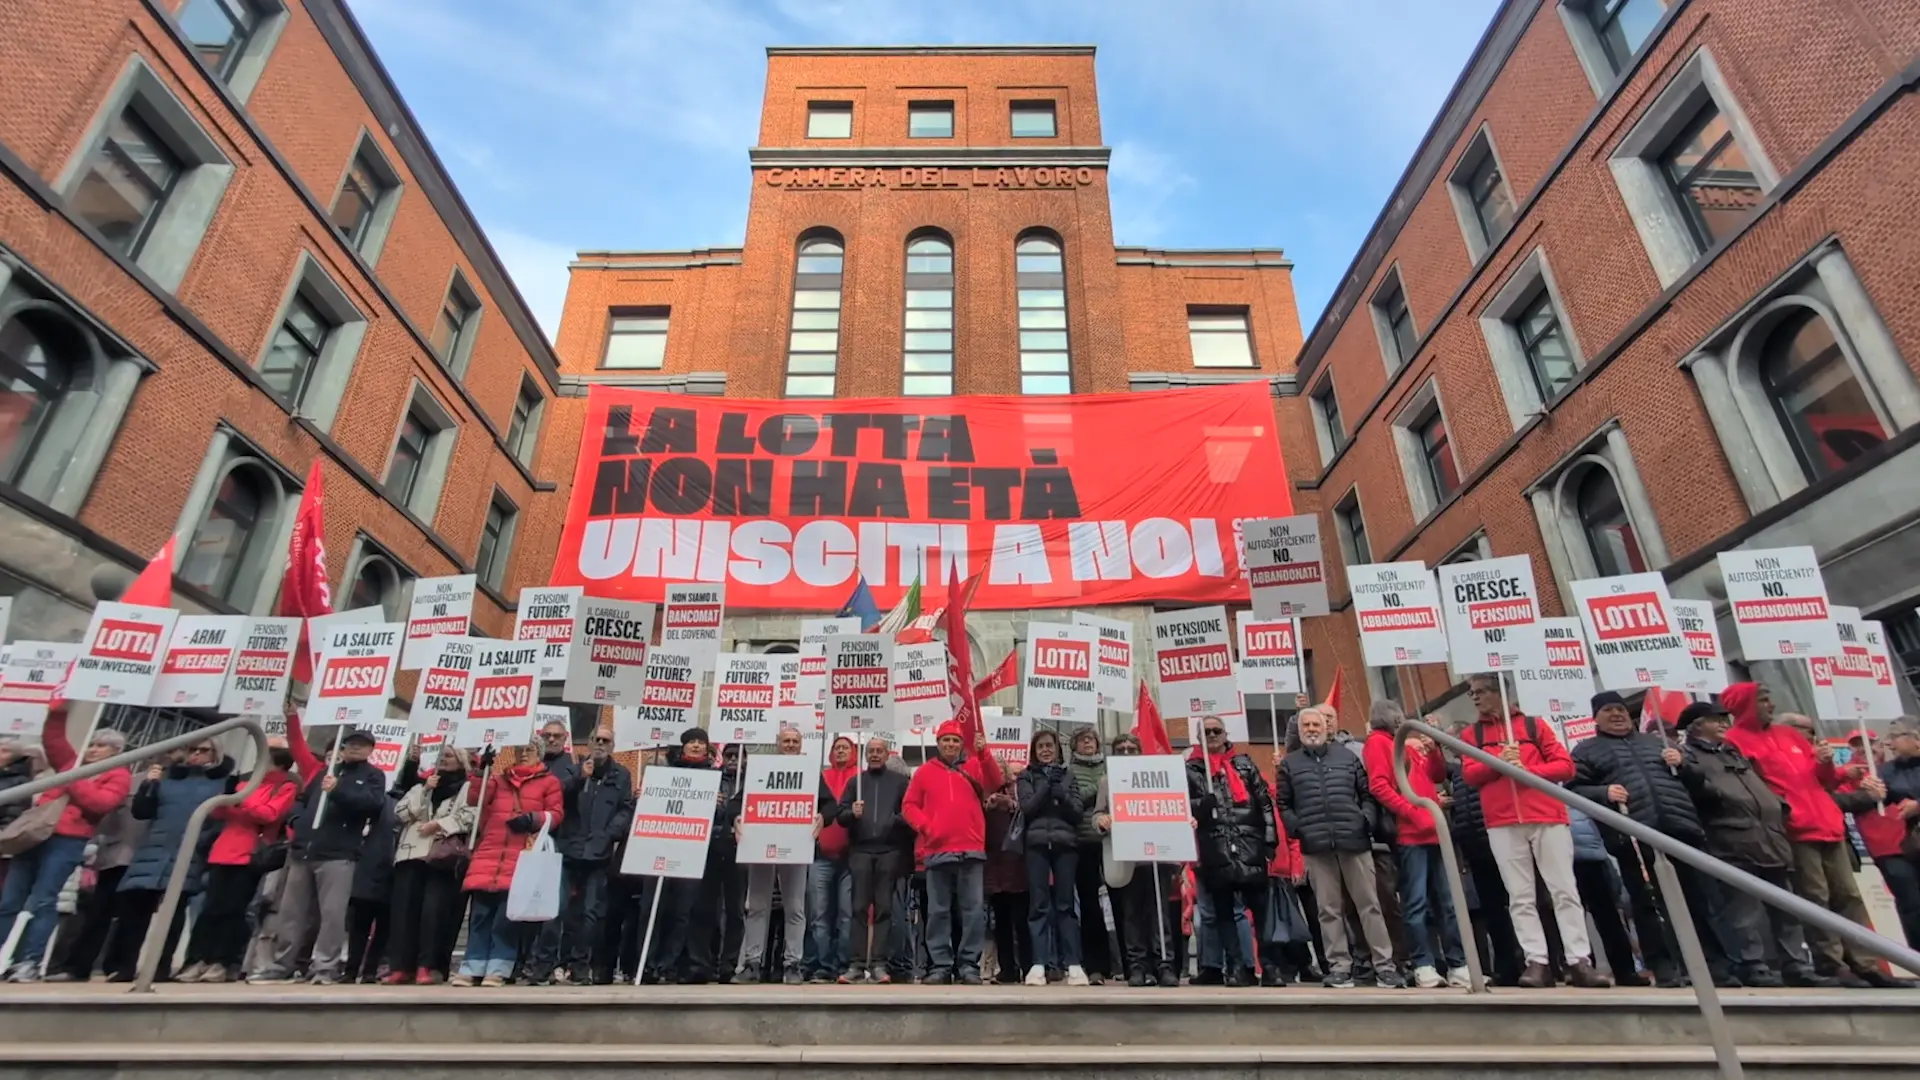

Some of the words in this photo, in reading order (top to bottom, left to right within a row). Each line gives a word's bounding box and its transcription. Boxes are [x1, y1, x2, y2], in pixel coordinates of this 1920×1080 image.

[765, 167, 887, 187] CAMERA
[900, 167, 959, 187] DEL
[972, 167, 1093, 187] LAVORO
[601, 404, 697, 456] LA
[715, 412, 976, 463] LOTTA
[588, 457, 774, 516] NON
[789, 460, 910, 518] HA
[927, 448, 1082, 520] ETÀ
[1269, 525, 1290, 537] NON
[1248, 534, 1316, 550] AUTOSUFFICIENTI?
[578, 517, 969, 586] UNISCITI
[988, 524, 1052, 585] A
[1067, 517, 1225, 581] NOI
[1755, 558, 1780, 569] NON
[1377, 571, 1397, 582] NON
[1452, 574, 1459, 584] IL
[1461, 570, 1500, 583] CARRELLO
[1728, 568, 1814, 583] AUTOSUFFICIENTI?
[436, 584, 452, 593] NON
[1355, 580, 1425, 594] AUTOSUFFICIENTI?
[1455, 577, 1527, 603] CRESCE,
[533, 594, 568, 604] PENSIONI
[672, 593, 687, 602] NON
[688, 593, 710, 602] SIAMO
[712, 593, 718, 601] IL
[528, 605, 570, 618] FUTURE?
[595, 608, 629, 618] CARRELLO
[668, 610, 719, 623] BANCOMAT
[1458, 606, 1467, 615] LE
[1472, 604, 1531, 624] PENSIONI
[1594, 603, 1664, 631] LOTTA
[189, 629, 226, 644] ARMI
[521, 622, 570, 639] SPERANZE
[585, 618, 644, 640] CRESCE,
[667, 629, 680, 640] DEL
[682, 629, 716, 639] GOVERNO.
[823, 626, 838, 634] NON
[1120, 631, 1126, 640] IL
[1156, 625, 1168, 639] IN
[1170, 619, 1222, 638] PENSIONE
[1485, 629, 1507, 643] NO!
[1566, 629, 1574, 638] IL
[1837, 623, 1857, 641] RMI
[96, 628, 156, 654] LOTTA
[247, 636, 287, 650] FUTURE?
[333, 634, 348, 647] LA
[350, 632, 395, 646] SALUTE
[842, 641, 879, 651] PENSIONI
[1174, 638, 1184, 646] MA
[1185, 637, 1197, 645] NON
[1247, 631, 1292, 650] LOTTA
[1594, 642, 1621, 655] NON
[1622, 636, 1682, 654] INVECCHIA!
[583, 638, 590, 646] LE
[593, 644, 643, 662] PENSIONI
[907, 651, 923, 659] NON
[175, 654, 228, 669] WELFARE
[237, 656, 285, 671] SPERANZE
[479, 652, 492, 666] LA
[495, 650, 537, 665] SALUTE
[651, 653, 690, 666] PENSIONI
[731, 660, 767, 669] PENSIONI
[838, 654, 882, 667] FUTURE?
[1037, 647, 1087, 671] LOTTA
[1161, 652, 1228, 676] SILENZIO!
[1243, 659, 1258, 668] NON
[1259, 657, 1298, 668] INVECCHIA
[78, 659, 99, 670] NON
[101, 661, 155, 675] INVECCHIA!
[598, 665, 616, 678] NO!
[645, 666, 692, 681] FUTURE?
[1520, 669, 1537, 680] DEL
[1539, 669, 1586, 680] GOVERNO.
[235, 677, 276, 691] PASSATE.
[323, 666, 384, 689] LUSSO
[726, 672, 769, 684] FUTURE?
[833, 674, 886, 689] SPERANZE
[1028, 677, 1046, 687] NON
[1047, 679, 1095, 692] INVECCHIA!
[472, 685, 528, 711] LUSSO
[644, 686, 693, 703] PERANZE
[720, 690, 772, 704] SPERANZE
[836, 695, 883, 709] PASSATE.
[637, 706, 686, 723] PASSATE.
[721, 709, 767, 722] PASSATE.
[375, 725, 406, 736] SALUTE
[996, 728, 1020, 740] ARMI
[671, 776, 692, 787] NON
[766, 771, 803, 790] ARMI
[1132, 771, 1170, 788] ARMI
[644, 787, 714, 801] AUTOSUFFICIENTI?
[757, 801, 811, 818] WELFARE
[1125, 800, 1185, 816] WELFARE
